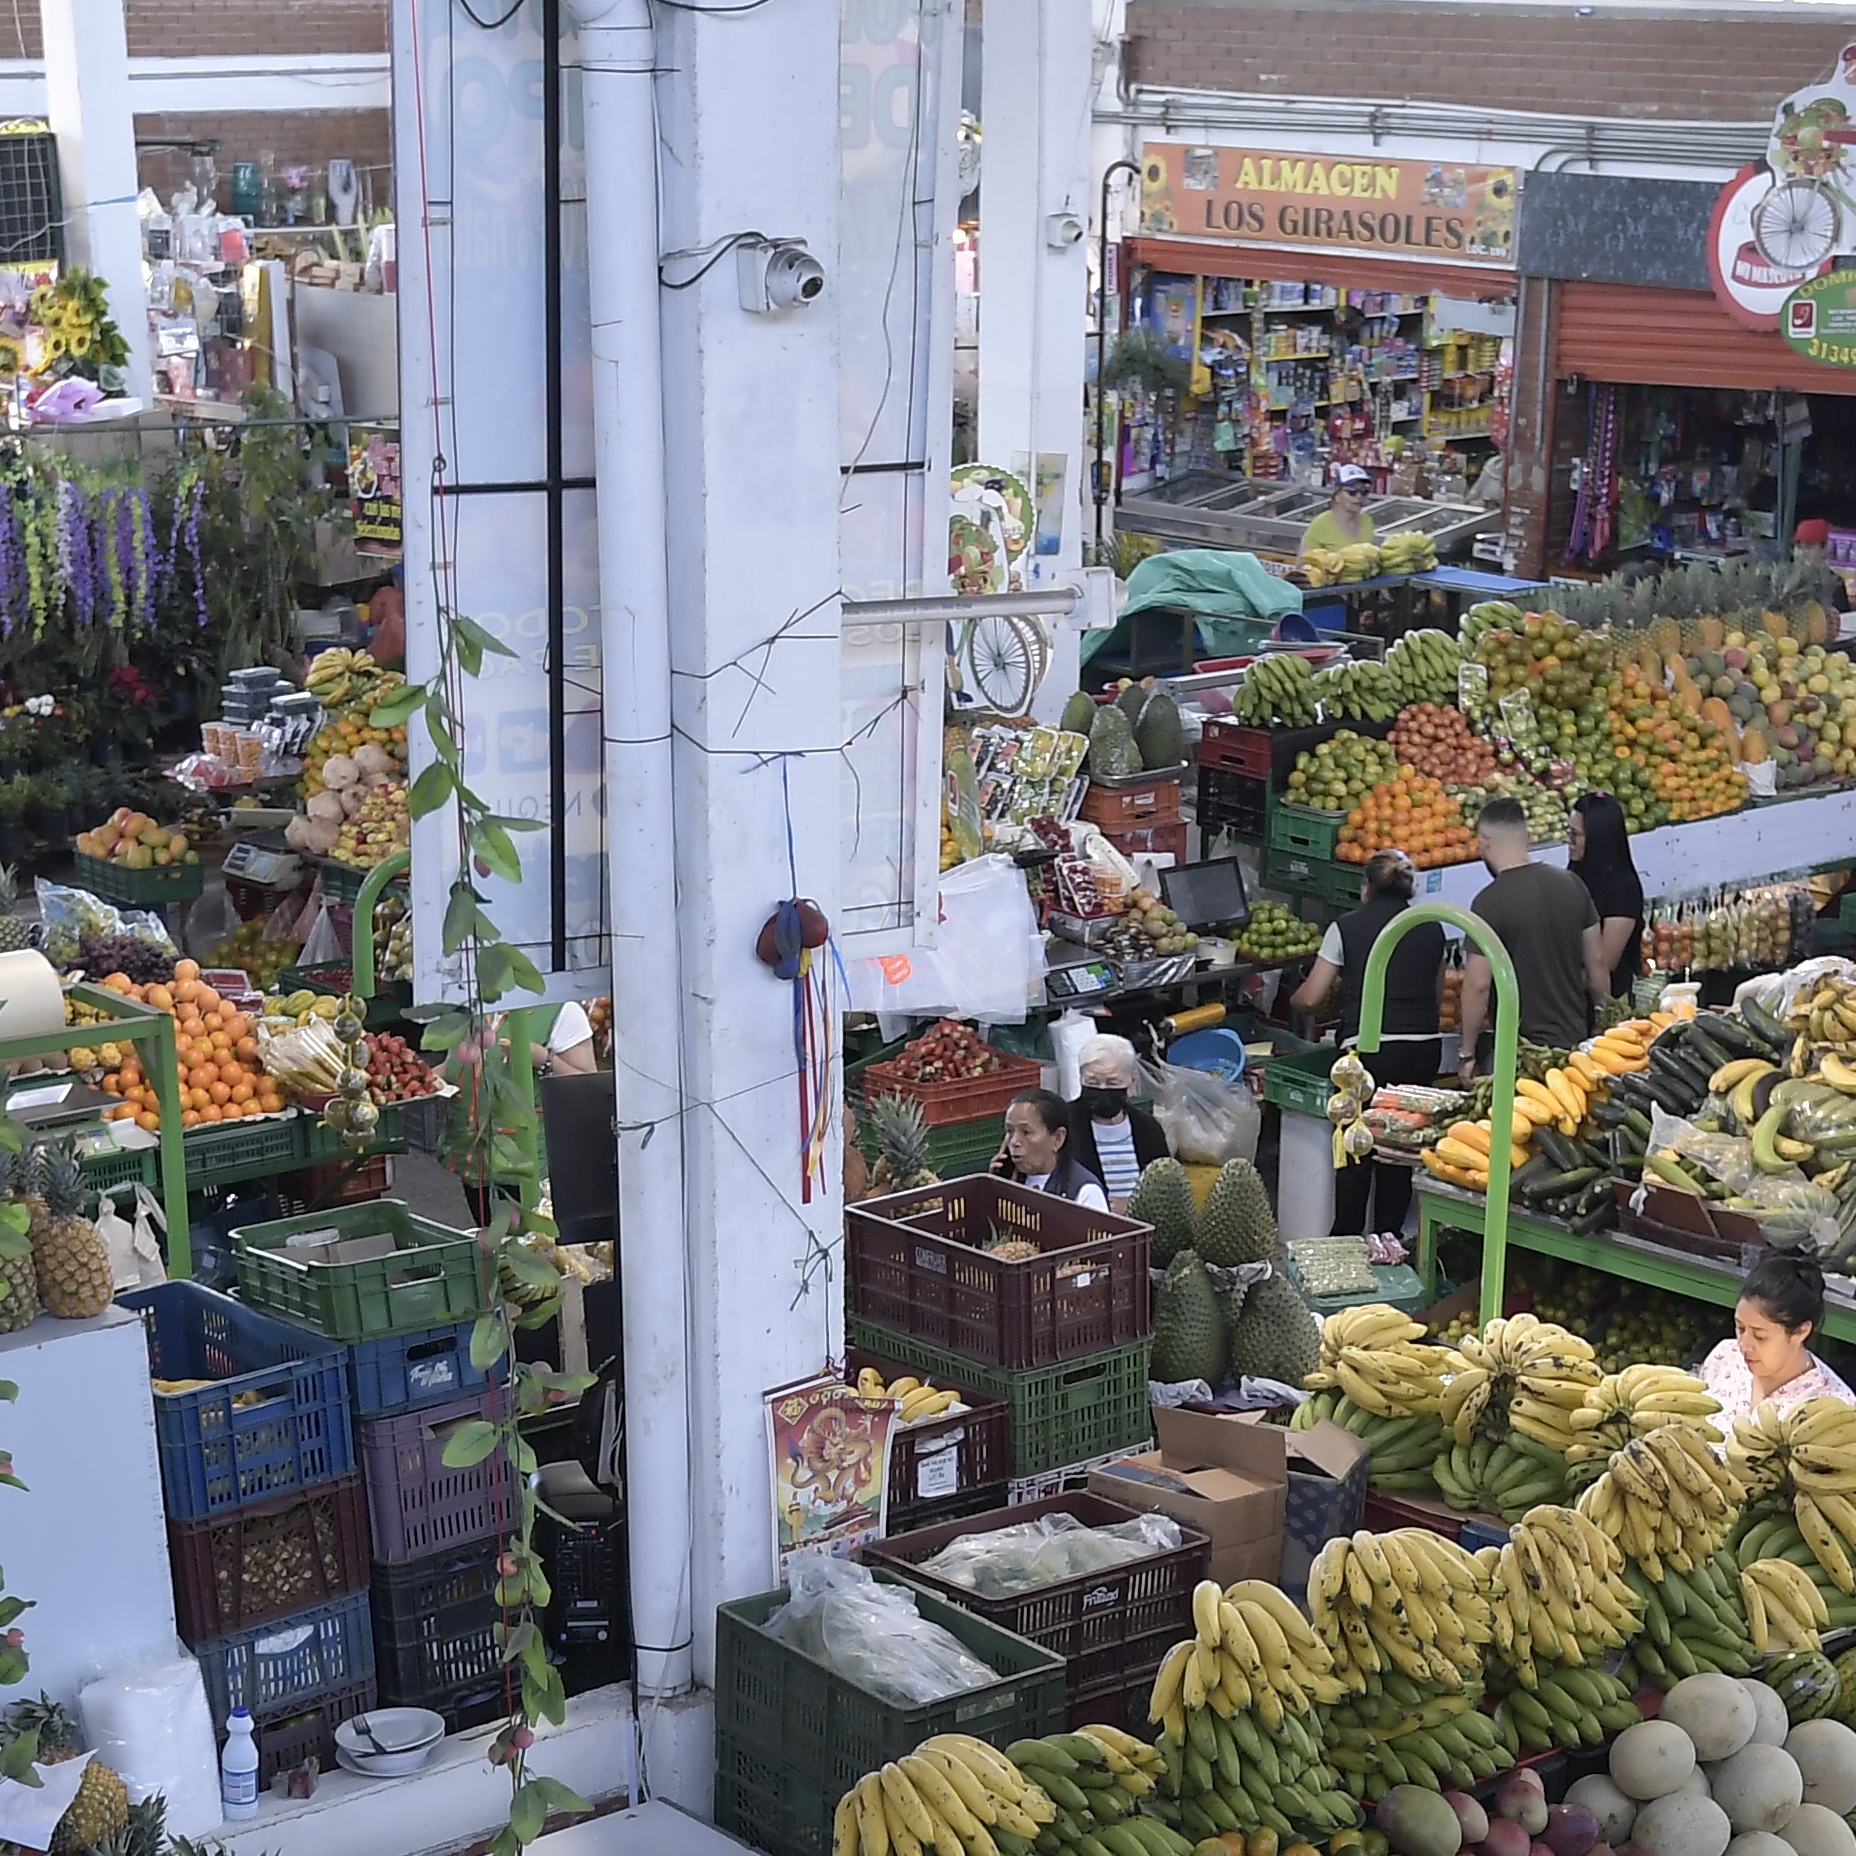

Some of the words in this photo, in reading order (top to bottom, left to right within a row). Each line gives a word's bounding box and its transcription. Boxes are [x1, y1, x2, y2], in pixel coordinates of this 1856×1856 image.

[1235, 155, 1400, 200] ALMACEN
[1204, 199, 1266, 234] LOS
[1277, 204, 1464, 250] GIRASOLES
